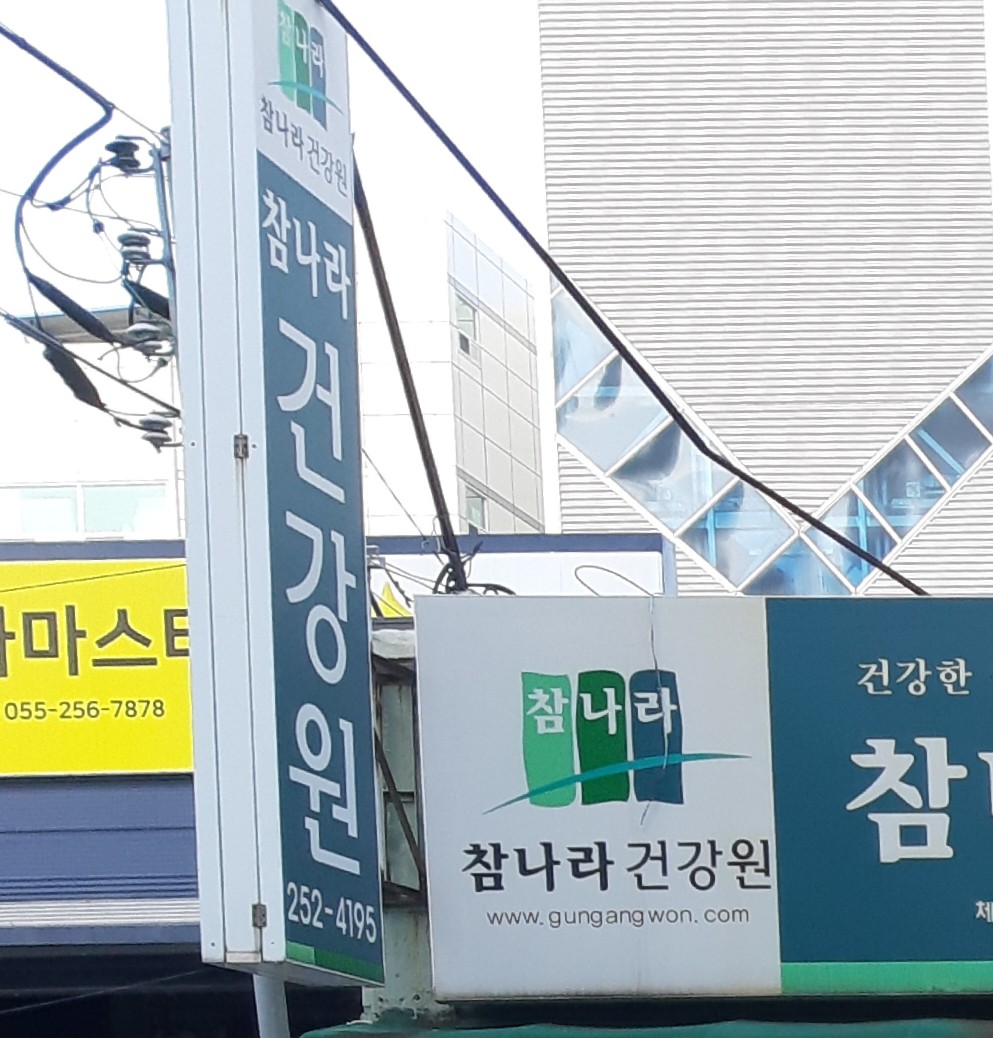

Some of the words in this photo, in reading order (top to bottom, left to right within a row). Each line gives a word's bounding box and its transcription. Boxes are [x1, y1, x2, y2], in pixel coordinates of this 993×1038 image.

[279, 11, 323, 78] 참나라
[262, 189, 351, 319] 참나라
[276, 317, 361, 875] 건강원
[857, 657, 973, 696] 건강한
[4, 699, 165, 721] 055-256-7878
[526, 687, 678, 735] 참나라
[287, 882, 377, 944] 252-4195
[486, 906, 750, 929] www.gungangwon.com
